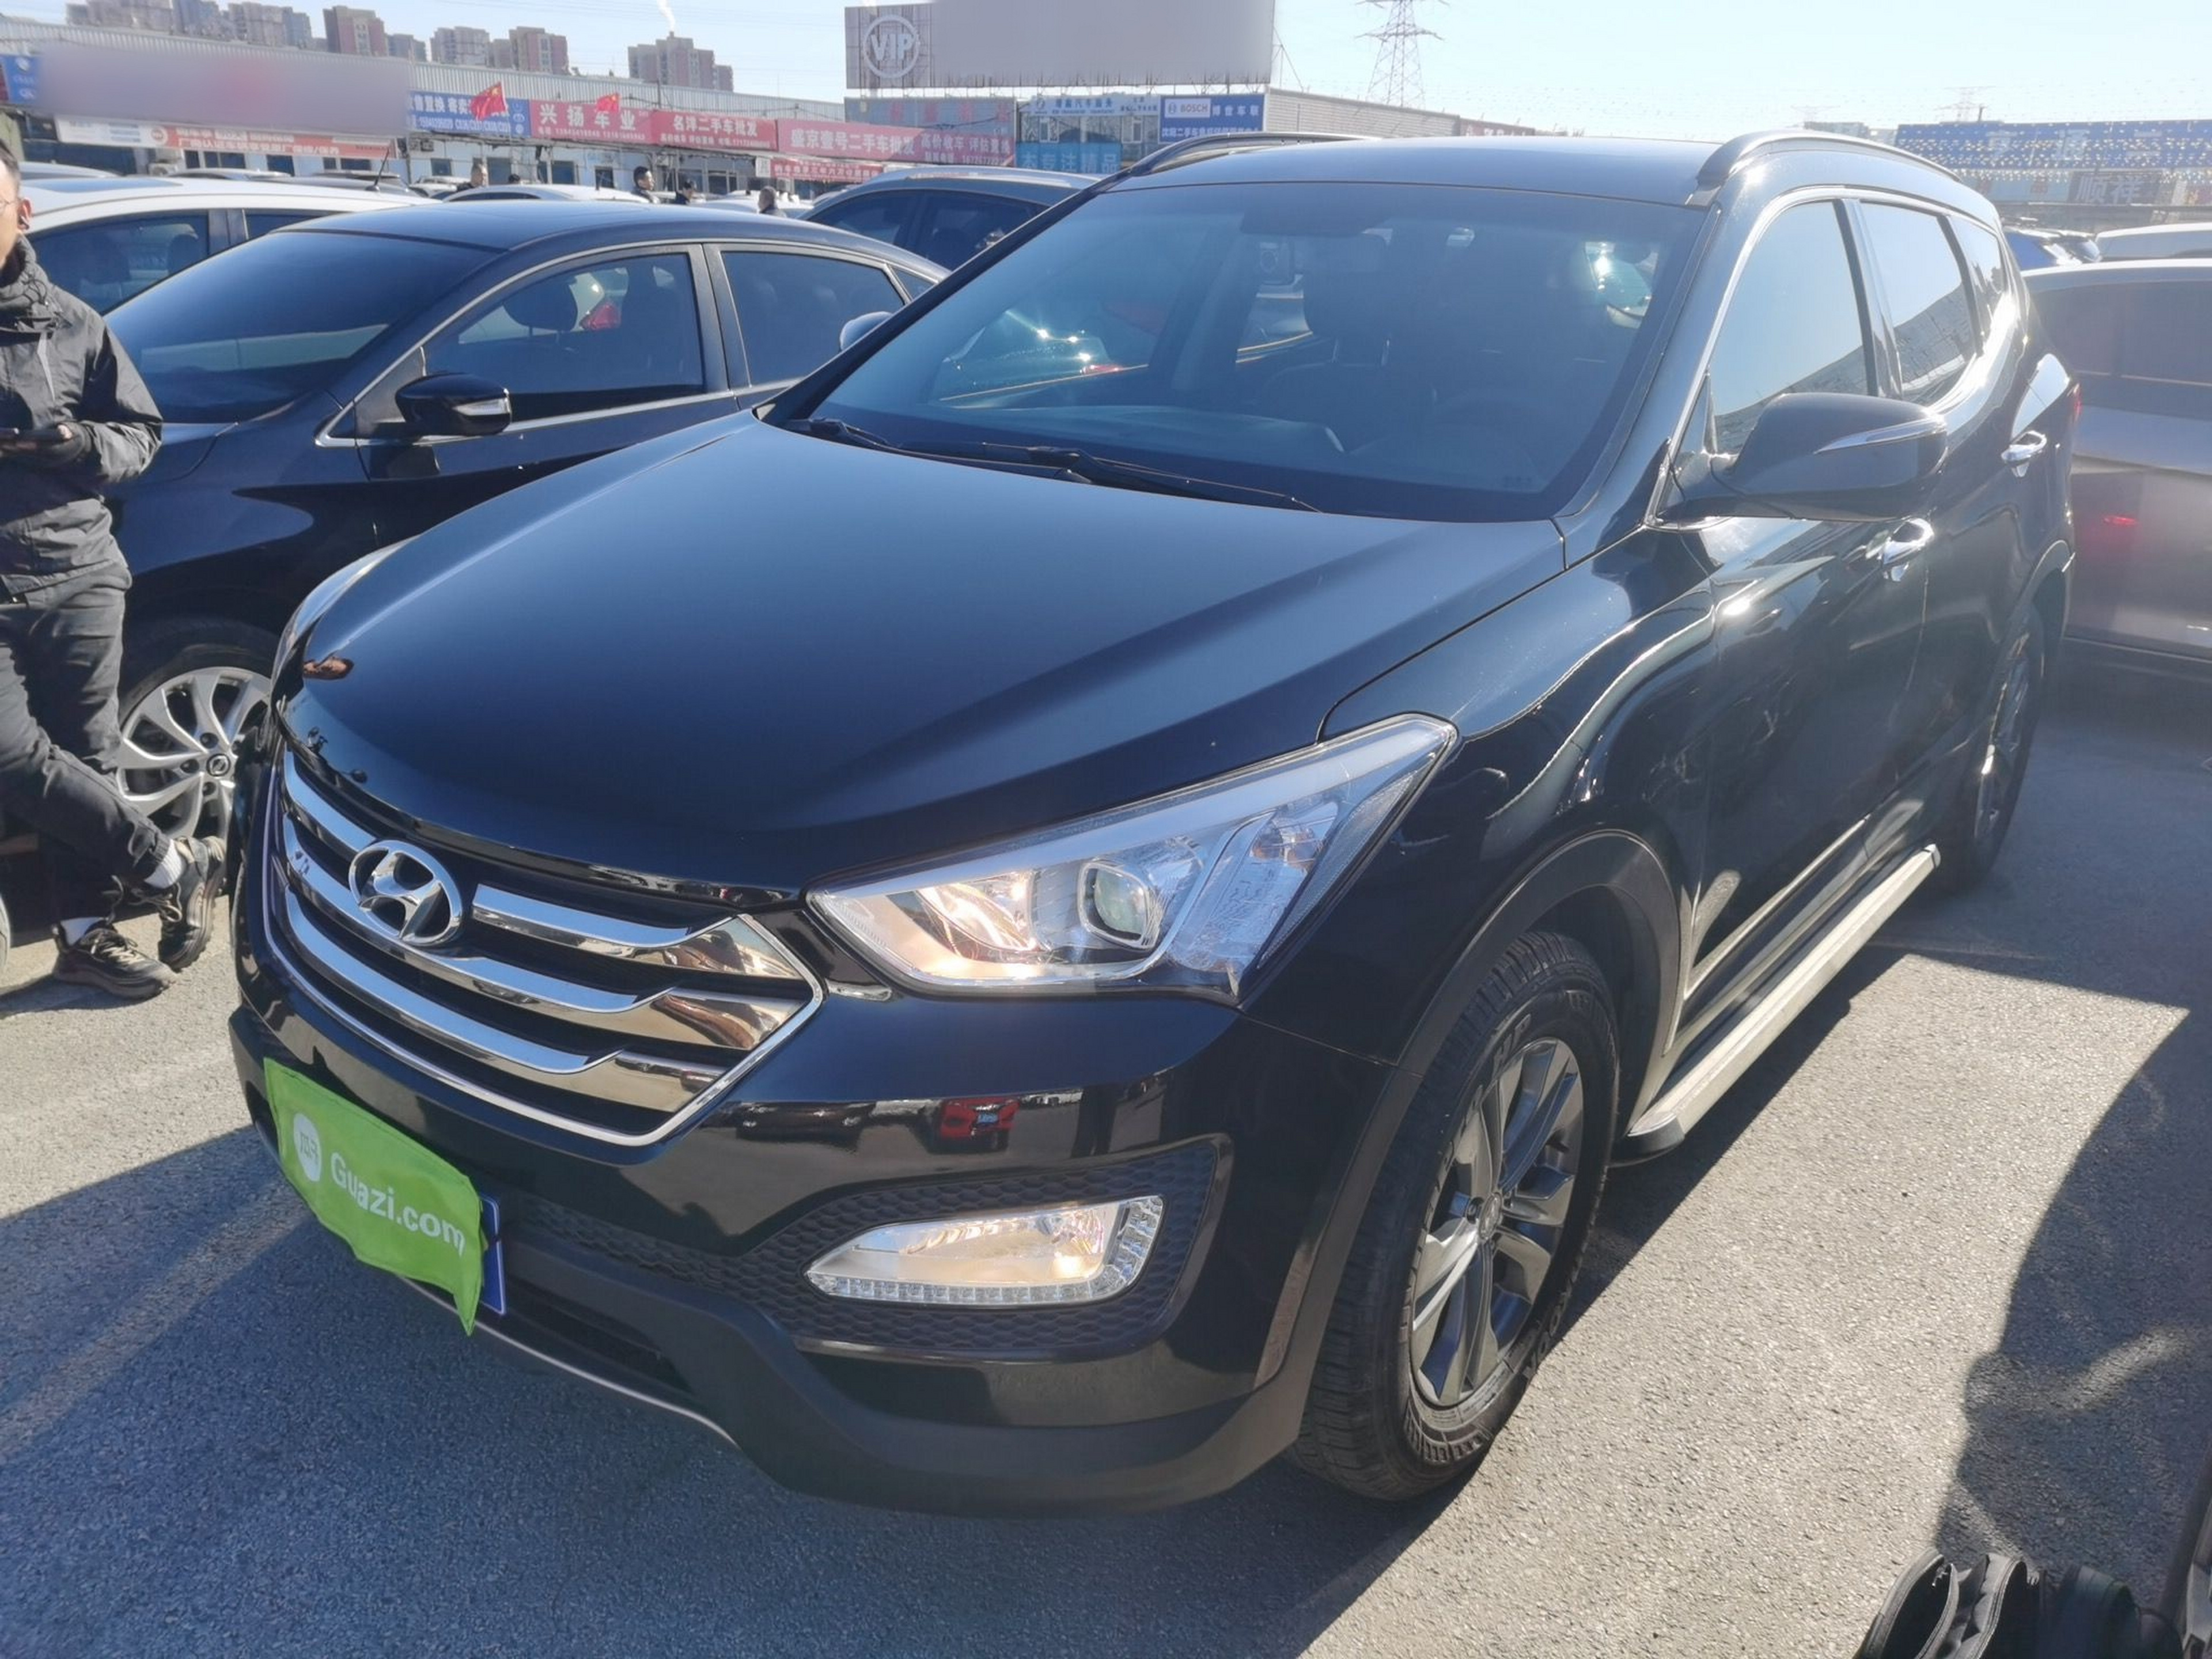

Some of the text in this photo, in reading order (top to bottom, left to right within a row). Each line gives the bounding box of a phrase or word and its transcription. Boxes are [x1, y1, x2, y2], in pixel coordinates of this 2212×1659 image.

[870, 33, 914, 60] VIP
[1180, 104, 1208, 113] BOSCH
[330, 1152, 465, 1257] Guazi.com
